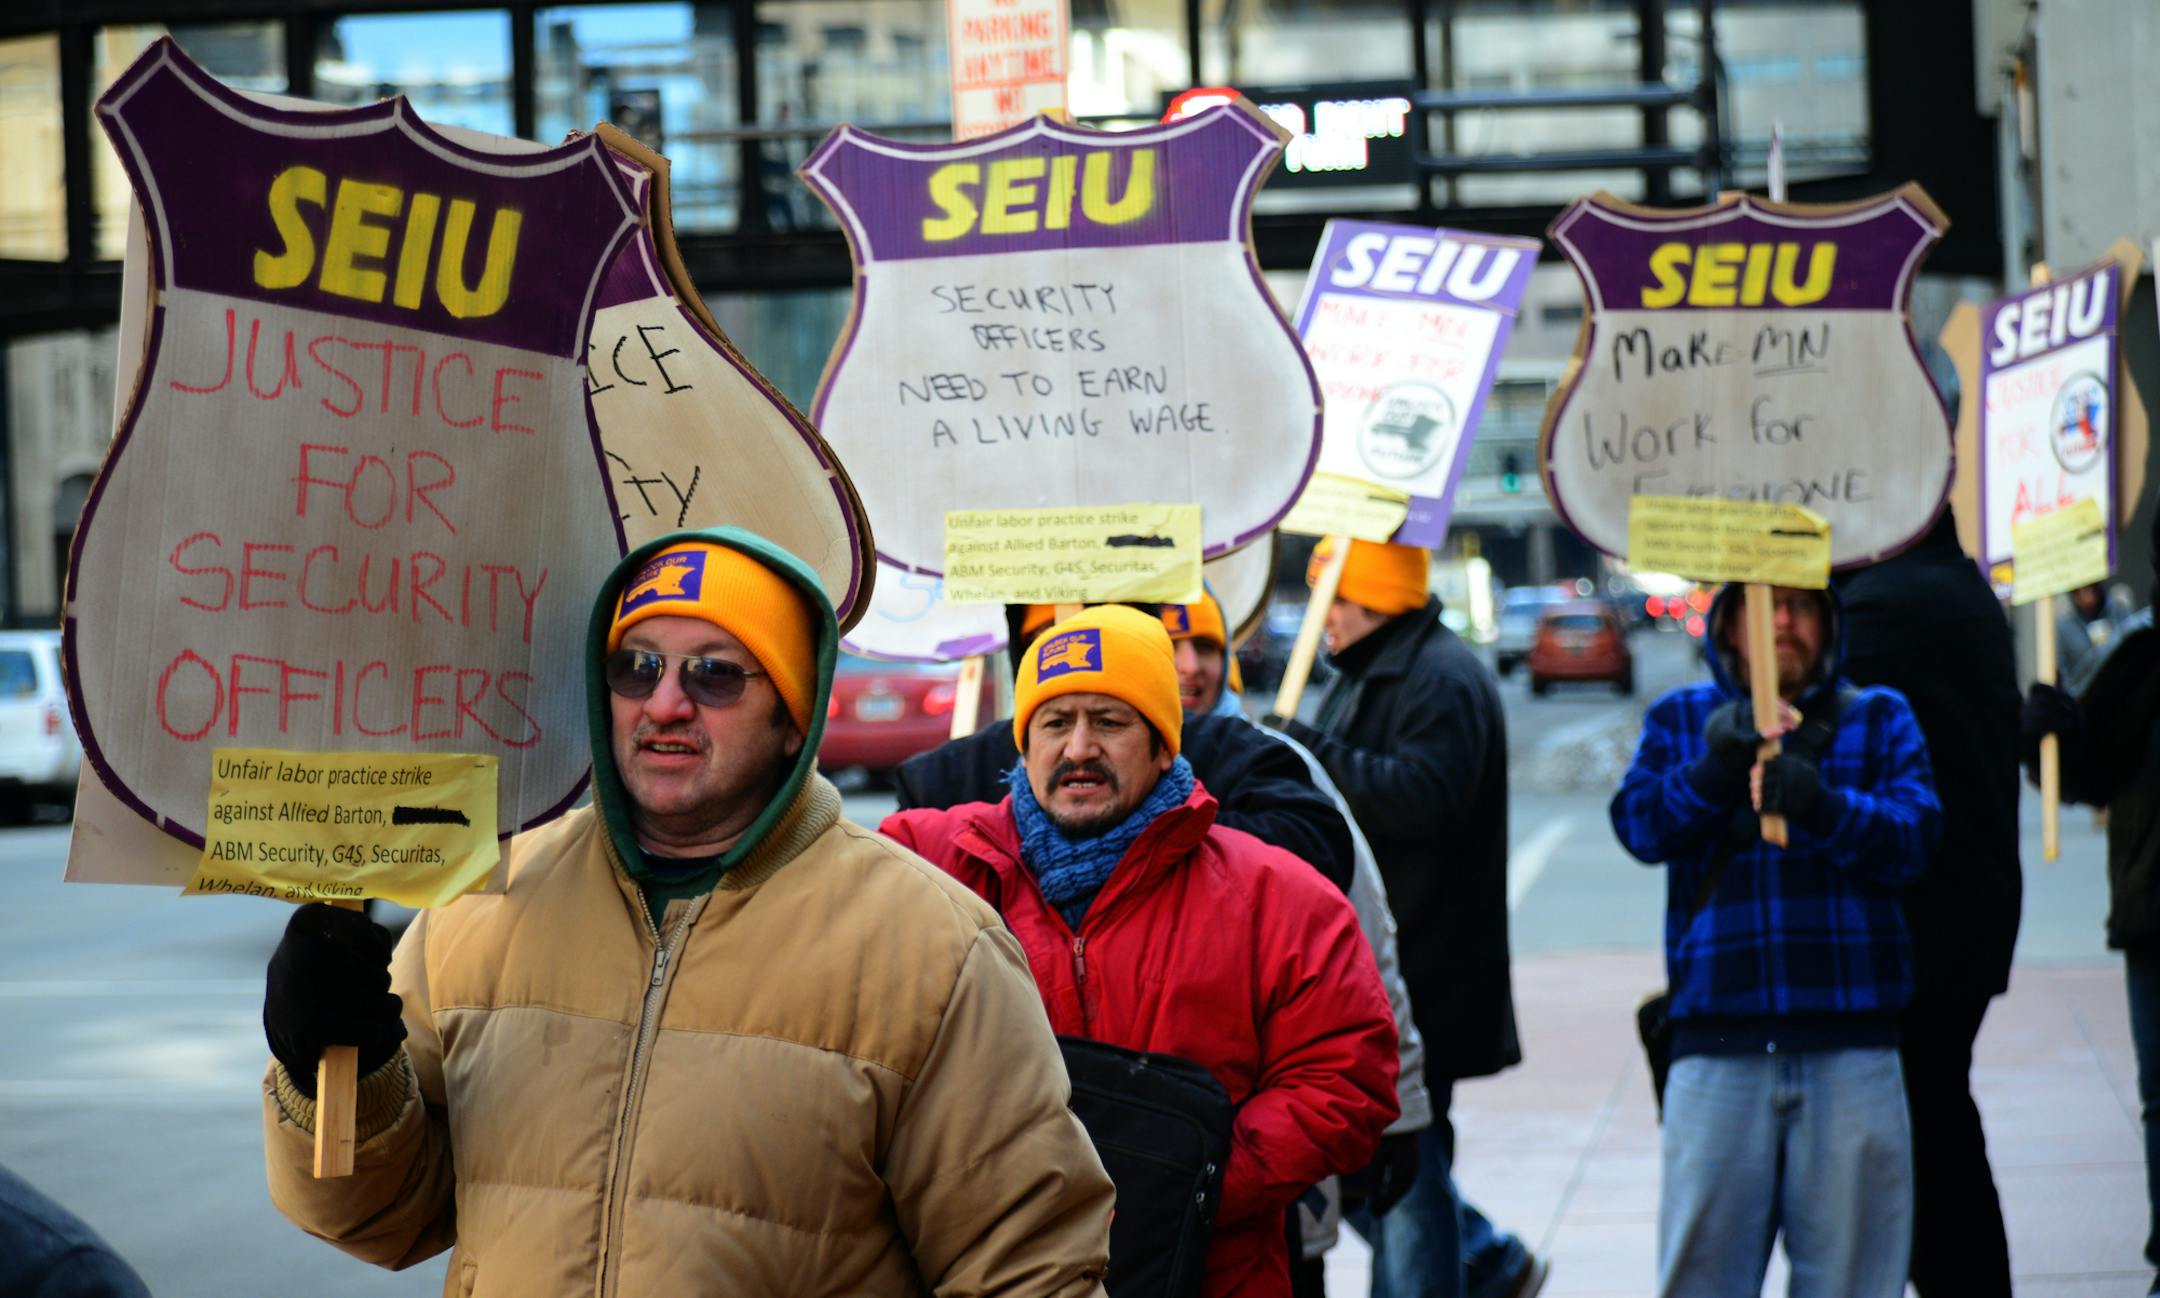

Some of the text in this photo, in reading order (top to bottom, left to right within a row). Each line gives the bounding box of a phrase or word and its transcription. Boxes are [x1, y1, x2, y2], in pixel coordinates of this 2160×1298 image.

[922, 148, 1156, 241] SEIU
[253, 166, 522, 318] SEIU
[1330, 232, 1521, 301] SEIU
[1641, 241, 1838, 308] SEIU
[931, 283, 1116, 316] SECURITY
[1990, 269, 2109, 368] SEIU
[970, 324, 1106, 352] OFFICERS
[1751, 321, 1830, 370] MN
[170, 308, 543, 436] JUSTICE
[899, 365, 1168, 404] NEED TO EARN
[932, 419, 957, 447] A
[972, 408, 1103, 444] LIVING
[291, 443, 456, 535] FOR
[949, 511, 1138, 530] Unfair labor practice strike
[949, 540, 1000, 555] against
[1003, 538, 1045, 551] Allied
[170, 532, 547, 645] SECURITY
[950, 565, 984, 578] ABM
[1014, 586, 1042, 599] and
[1044, 585, 1089, 601] Viking
[157, 648, 541, 749] OFFICERS
[217, 758, 432, 788] Unfair labor practice strike
[213, 800, 387, 828] against Allied Barton,
[210, 840, 446, 867] ABM Security, G4S, Securitas,
[199, 877, 277, 898] Whelan,
[285, 882, 313, 898] and
